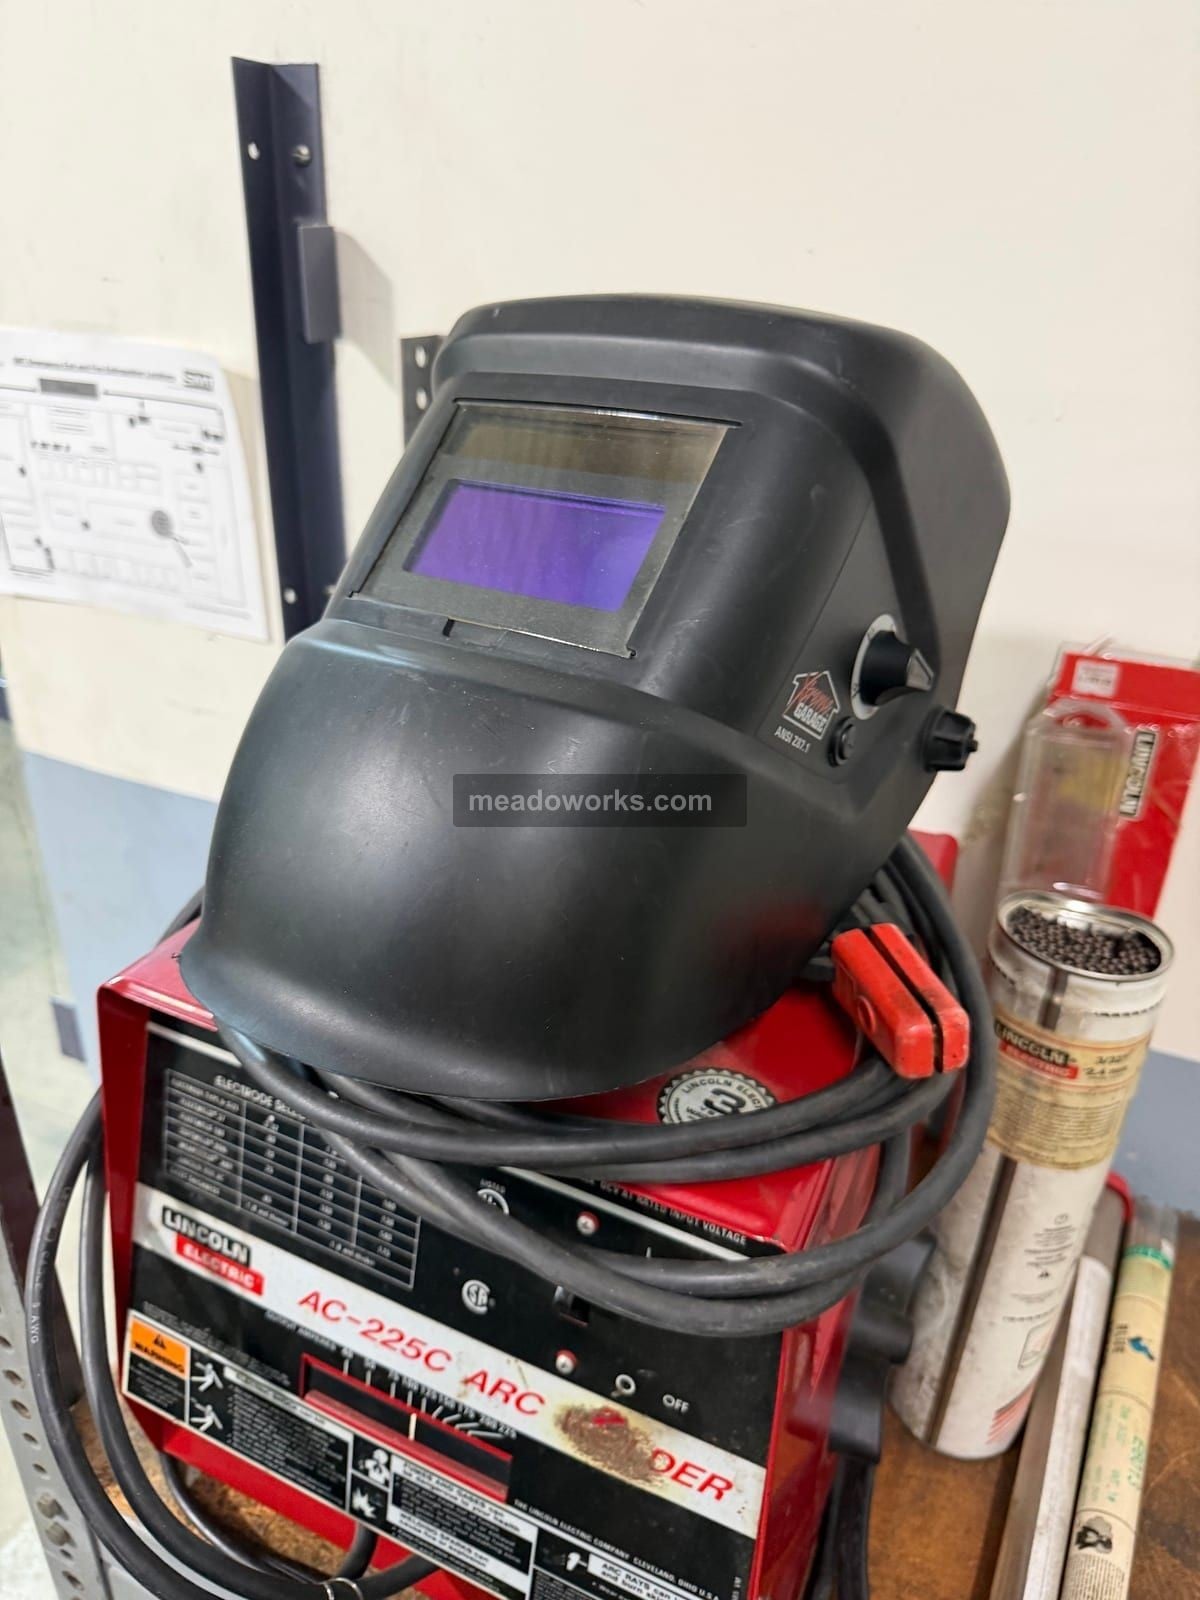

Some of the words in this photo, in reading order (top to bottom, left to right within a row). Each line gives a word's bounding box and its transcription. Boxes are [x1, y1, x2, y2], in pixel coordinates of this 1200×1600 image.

[774, 725, 794, 744] ANSI
[793, 702, 829, 734] GARAGE
[1119, 731, 1155, 815] LINCOLN
[996, 1022, 1066, 1065] LINCOLN
[214, 1074, 273, 1108] ELECTRODE
[682, 1079, 732, 1094] LINCOLN
[164, 1208, 249, 1265] LINCOLN
[637, 1193, 667, 1214] RATED
[669, 1206, 700, 1227] INPUT
[702, 1219, 747, 1246] VOLTAGE
[183, 1242, 255, 1289] ELECTRIC
[30, 1315, 41, 1344] AWG
[298, 1290, 452, 1372] AC-225C
[463, 1368, 546, 1416] ARC
[662, 1393, 690, 1414] OFF
[499, 1423, 517, 1439] 225
[513, 1498, 528, 1512] THE
[528, 1506, 559, 1527] LINCOLN
[560, 1520, 594, 1543] ELECTRIC
[593, 1538, 630, 1561] COMPANY
[632, 1556, 677, 1584] CLEVELAND,
[678, 1578, 699, 1594] OHIO
[601, 1570, 618, 1582] and
[622, 1579, 643, 1595] burn
[602, 1562, 622, 1577] ARC
[625, 1572, 651, 1591] RAYS
[653, 1587, 671, 1600] can
